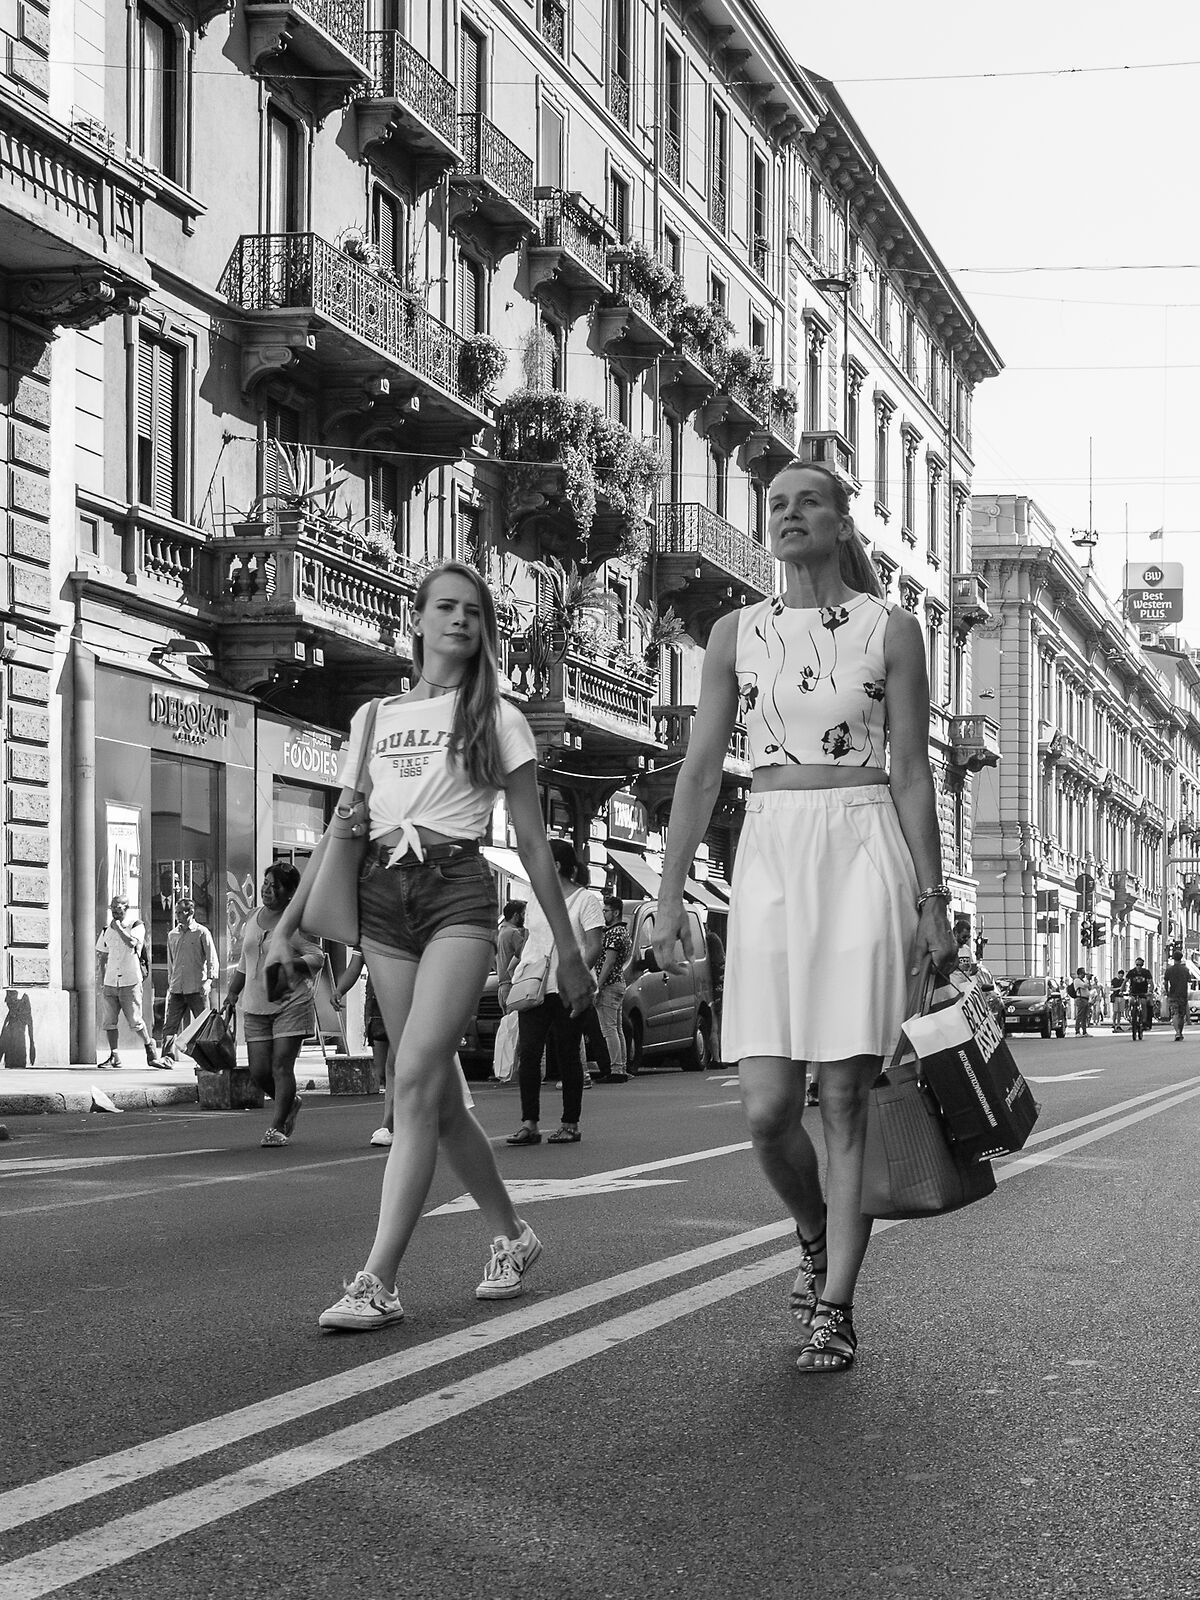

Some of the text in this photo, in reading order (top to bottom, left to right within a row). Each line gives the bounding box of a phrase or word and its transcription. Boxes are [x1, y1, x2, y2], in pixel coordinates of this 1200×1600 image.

[1144, 571, 1162, 581] BW
[1142, 591, 1164, 601] Best
[1133, 600, 1173, 609] Western
[1140, 609, 1166, 618] PLUS
[149, 692, 230, 738] DEBORAH
[283, 741, 338, 777] FOODIES
[392, 756, 430, 769] SINCE
[399, 766, 422, 778] 1969
